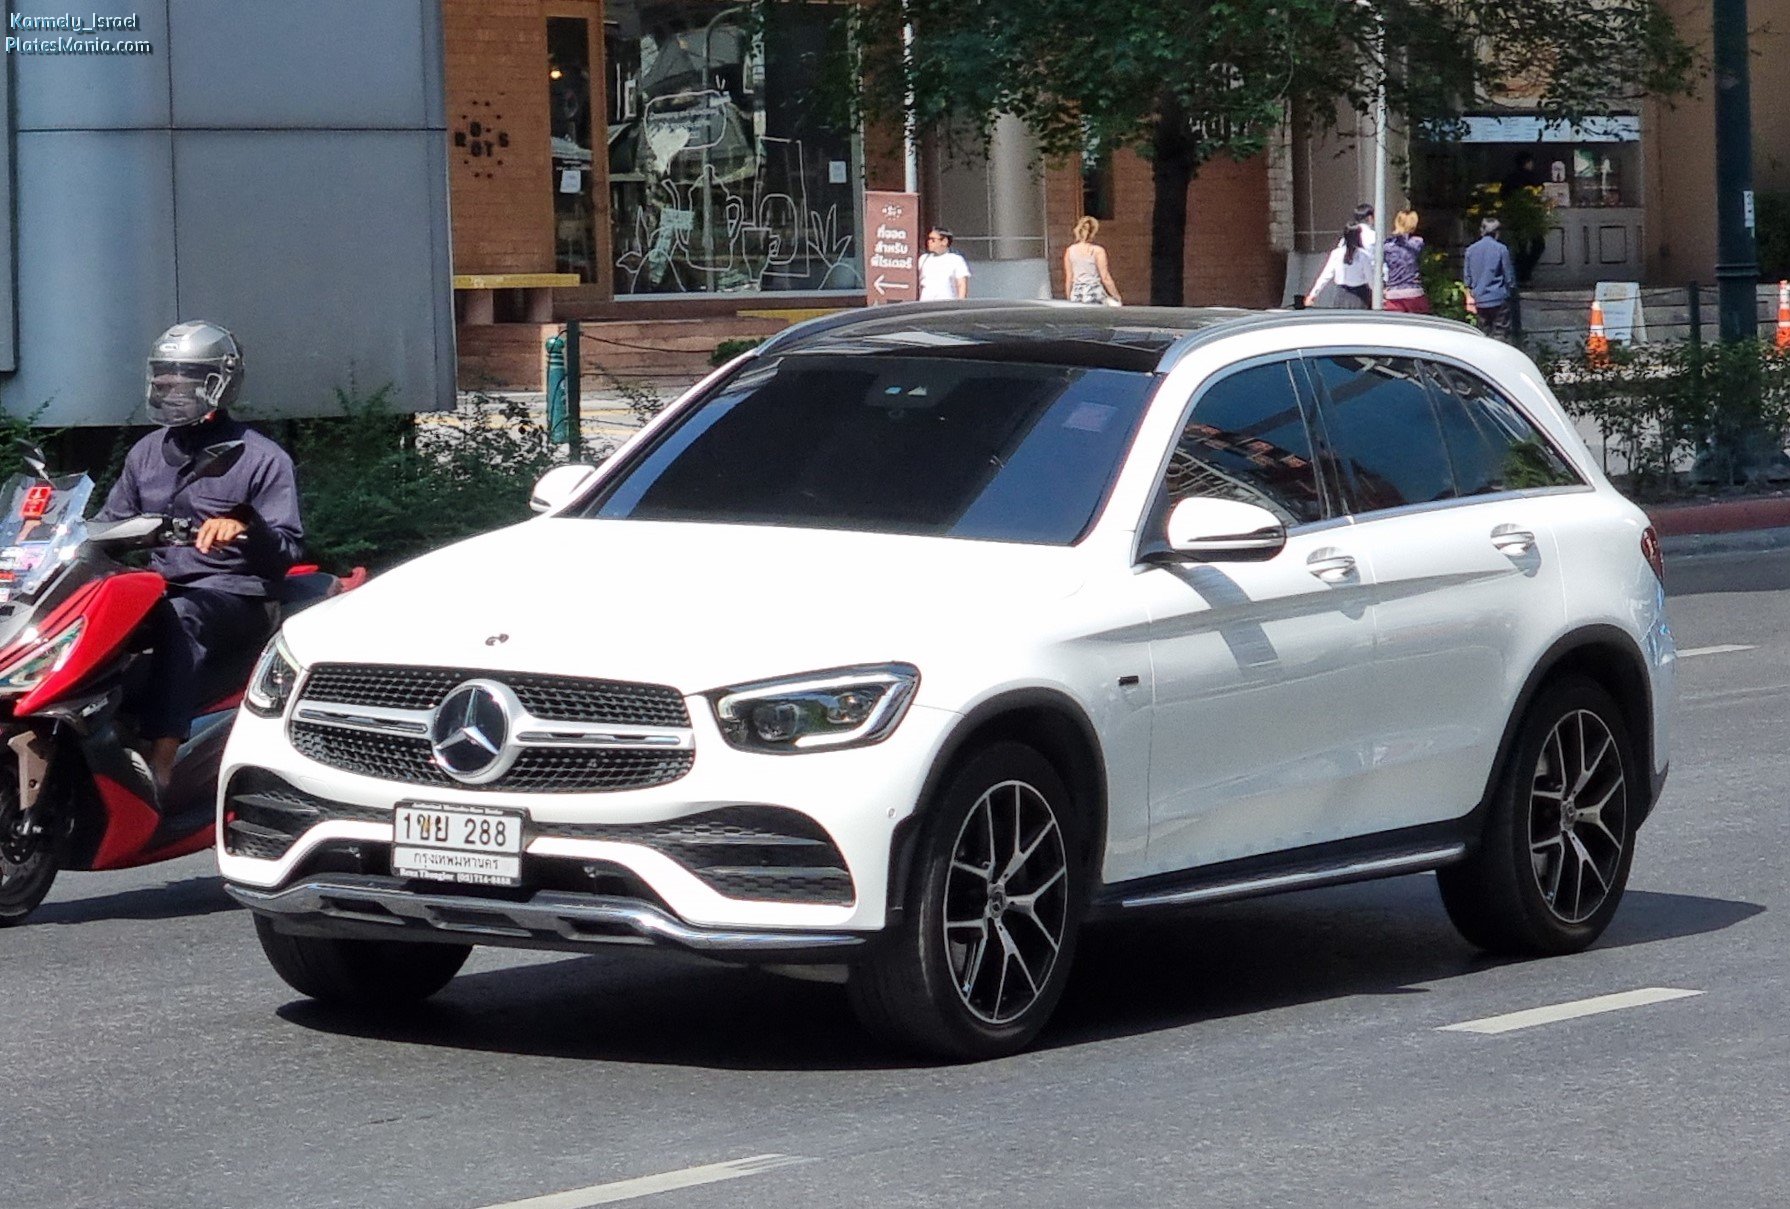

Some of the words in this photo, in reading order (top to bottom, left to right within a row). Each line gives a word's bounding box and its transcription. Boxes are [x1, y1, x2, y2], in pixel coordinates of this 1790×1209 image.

[464, 818, 506, 847] 288
[413, 852, 499, 870] กรุงเทพมหานคร
